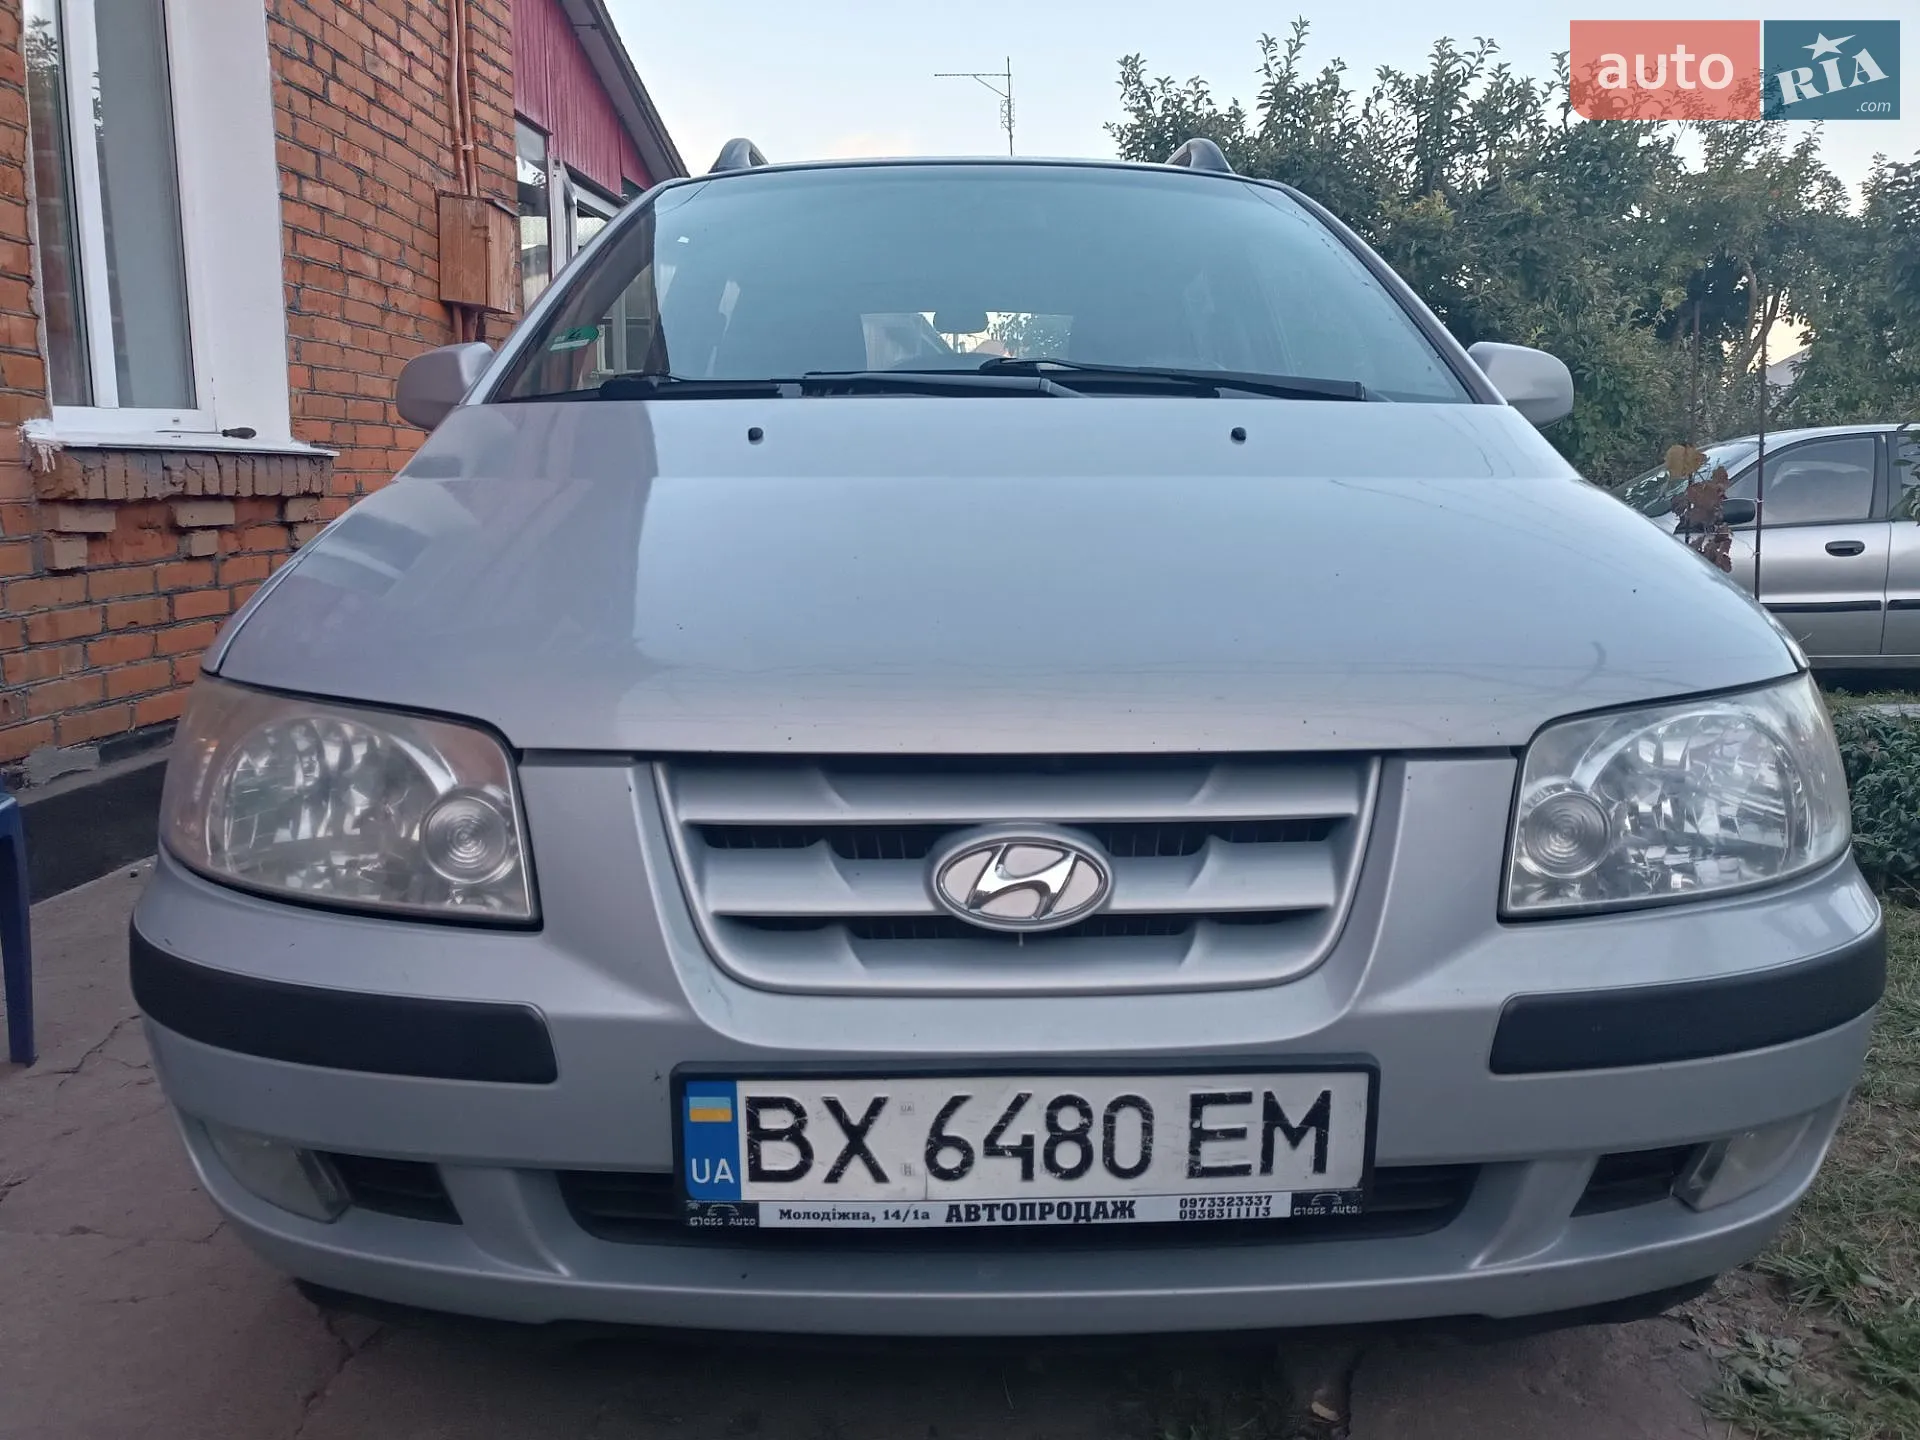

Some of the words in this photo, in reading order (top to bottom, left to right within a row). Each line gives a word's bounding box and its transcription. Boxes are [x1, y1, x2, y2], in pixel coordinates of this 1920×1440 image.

[746, 1095, 891, 1184] BX
[924, 1092, 1155, 1182] 6480
[1186, 1090, 1332, 1179] EM
[691, 1157, 735, 1184] UA
[1179, 1194, 1272, 1209] 0973323337
[778, 1206, 876, 1223] Молодіжна,
[945, 1200, 1136, 1223] АВТОПРОДАЖ
[1179, 1207, 1271, 1220] 0938311113
[728, 1216, 756, 1226] Auto
